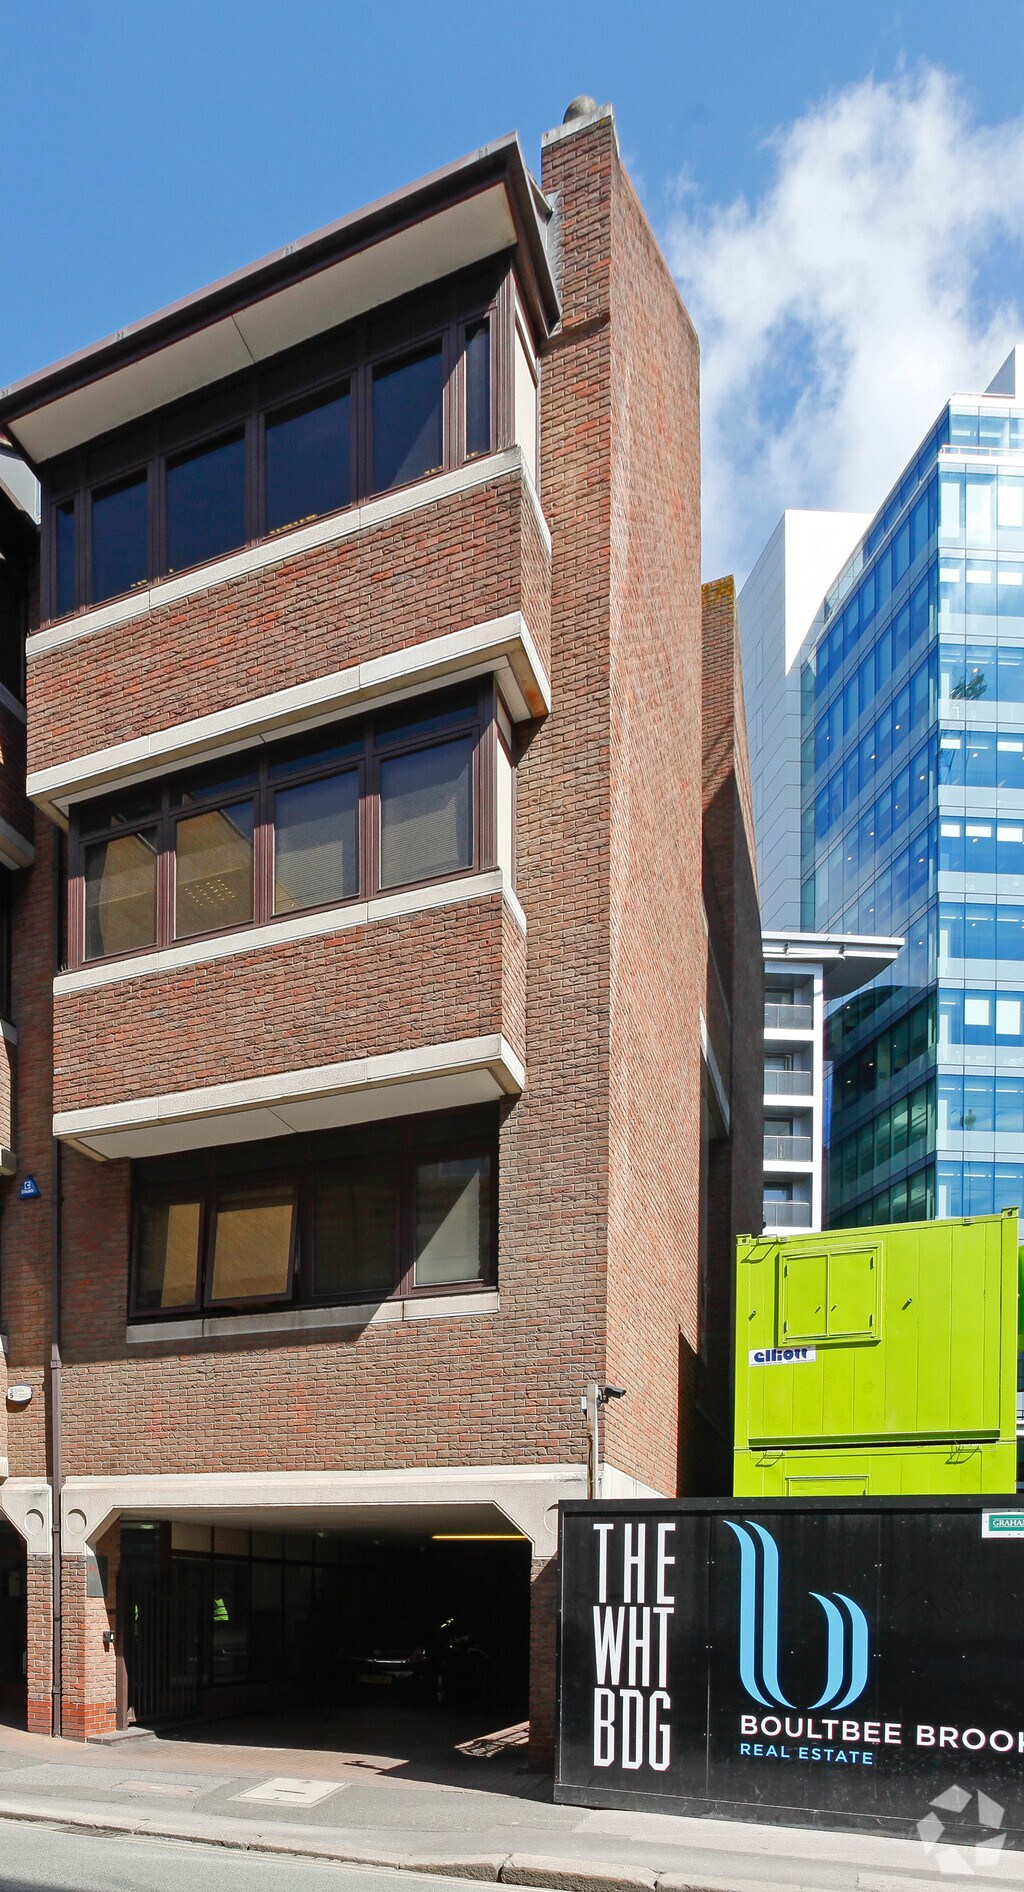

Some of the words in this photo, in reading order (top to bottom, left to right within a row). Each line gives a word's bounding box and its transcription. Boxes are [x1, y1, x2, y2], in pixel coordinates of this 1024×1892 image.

[992, 1519, 1024, 1527] GRAHA
[593, 1522, 676, 1604] THE
[592, 1605, 675, 1688] WHT
[593, 1687, 672, 1771] BDG
[740, 1714, 903, 1745] BOULTBEE
[740, 1743, 791, 1759] REAL
[798, 1747, 874, 1765] ESTATE
